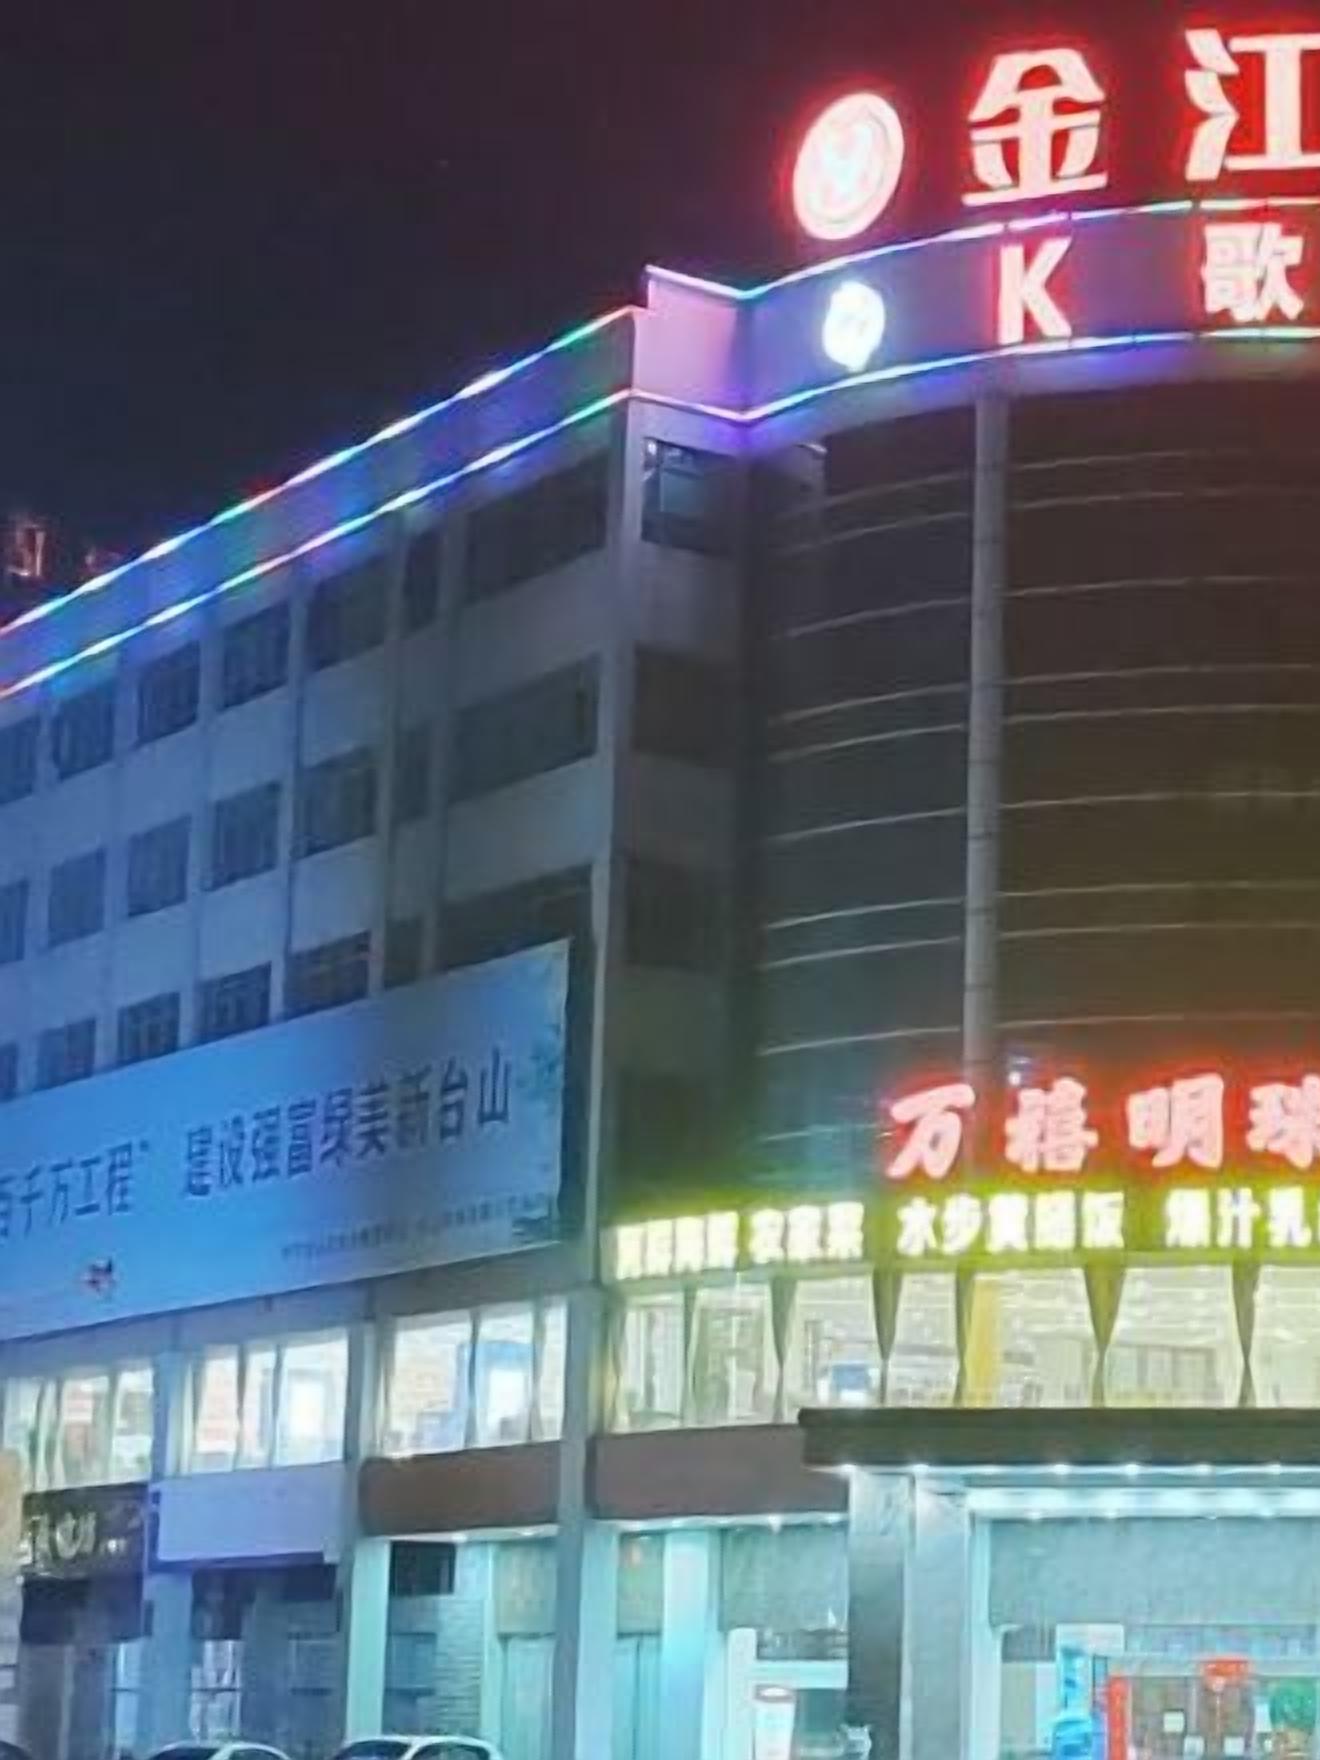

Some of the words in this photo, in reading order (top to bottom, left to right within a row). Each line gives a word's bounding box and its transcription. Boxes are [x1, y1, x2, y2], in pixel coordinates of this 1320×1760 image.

[184, 1046, 511, 1198] 建设强富绿美新台山
